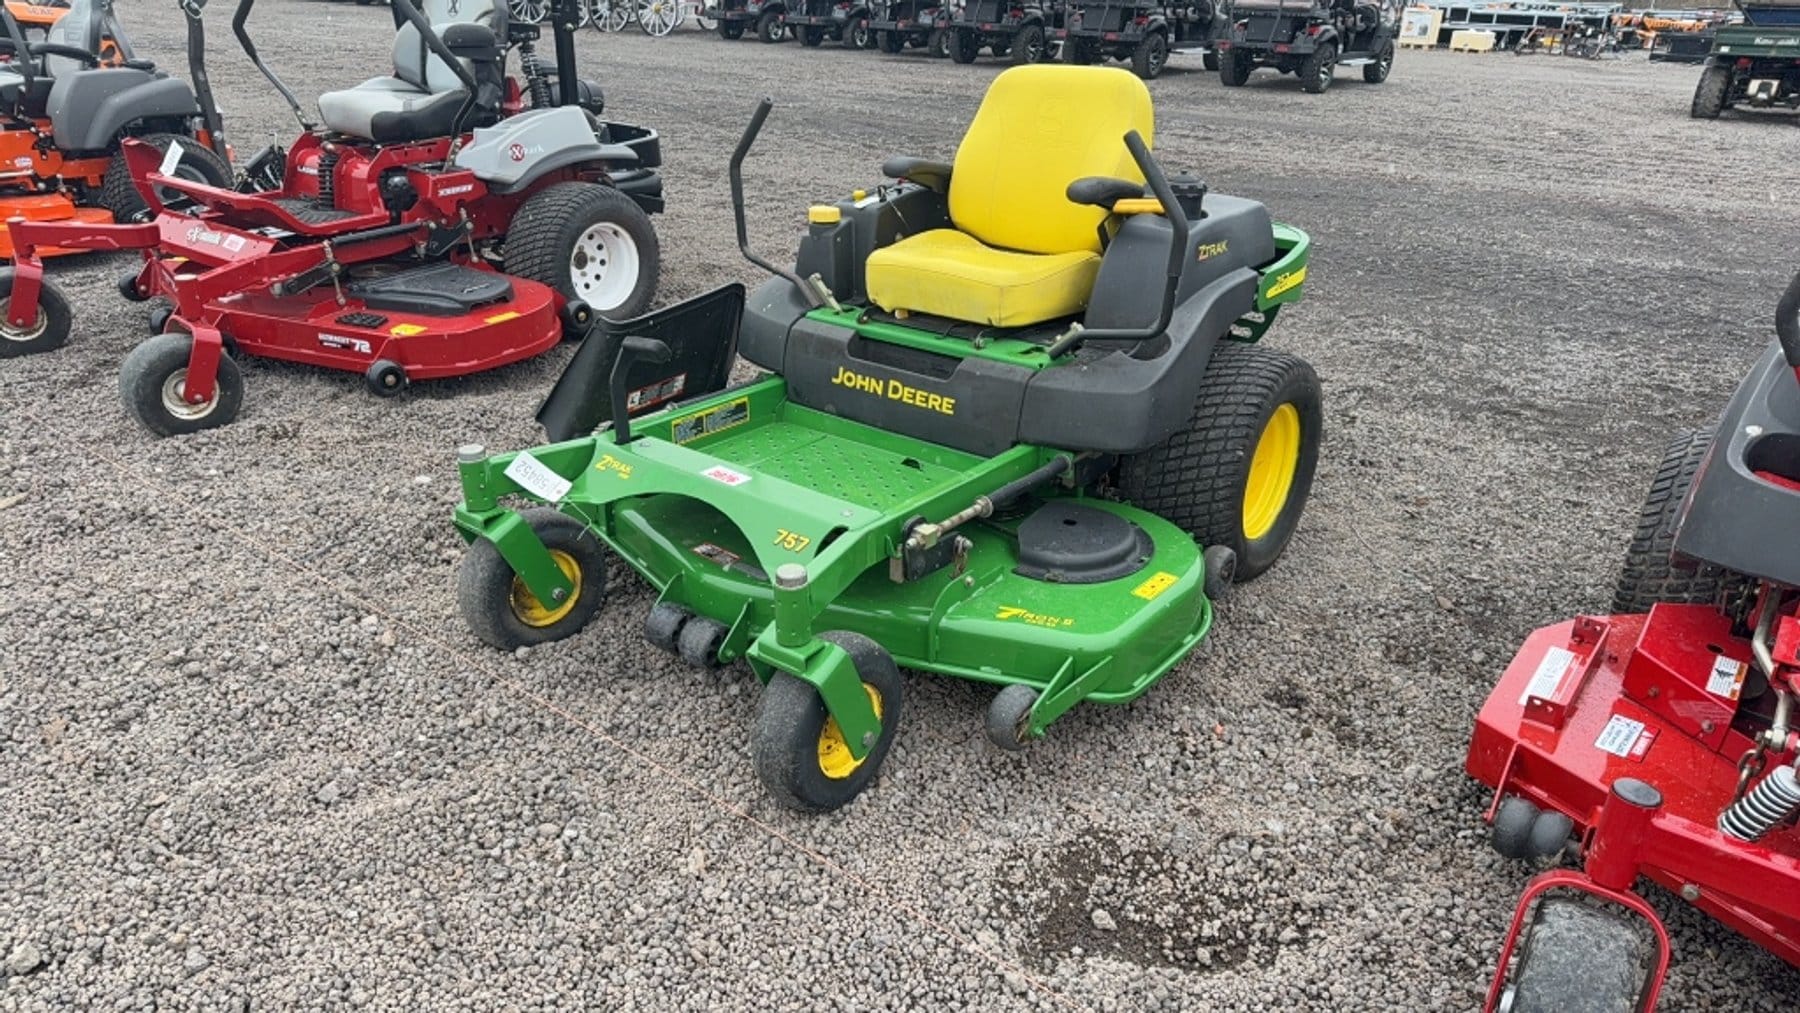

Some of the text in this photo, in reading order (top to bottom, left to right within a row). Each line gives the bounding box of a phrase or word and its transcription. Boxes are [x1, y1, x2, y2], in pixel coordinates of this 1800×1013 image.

[1198, 239, 1229, 261] ZTRAK
[351, 338, 372, 354] 72
[831, 366, 956, 415] JOHN DEERE
[773, 528, 810, 553] 757
